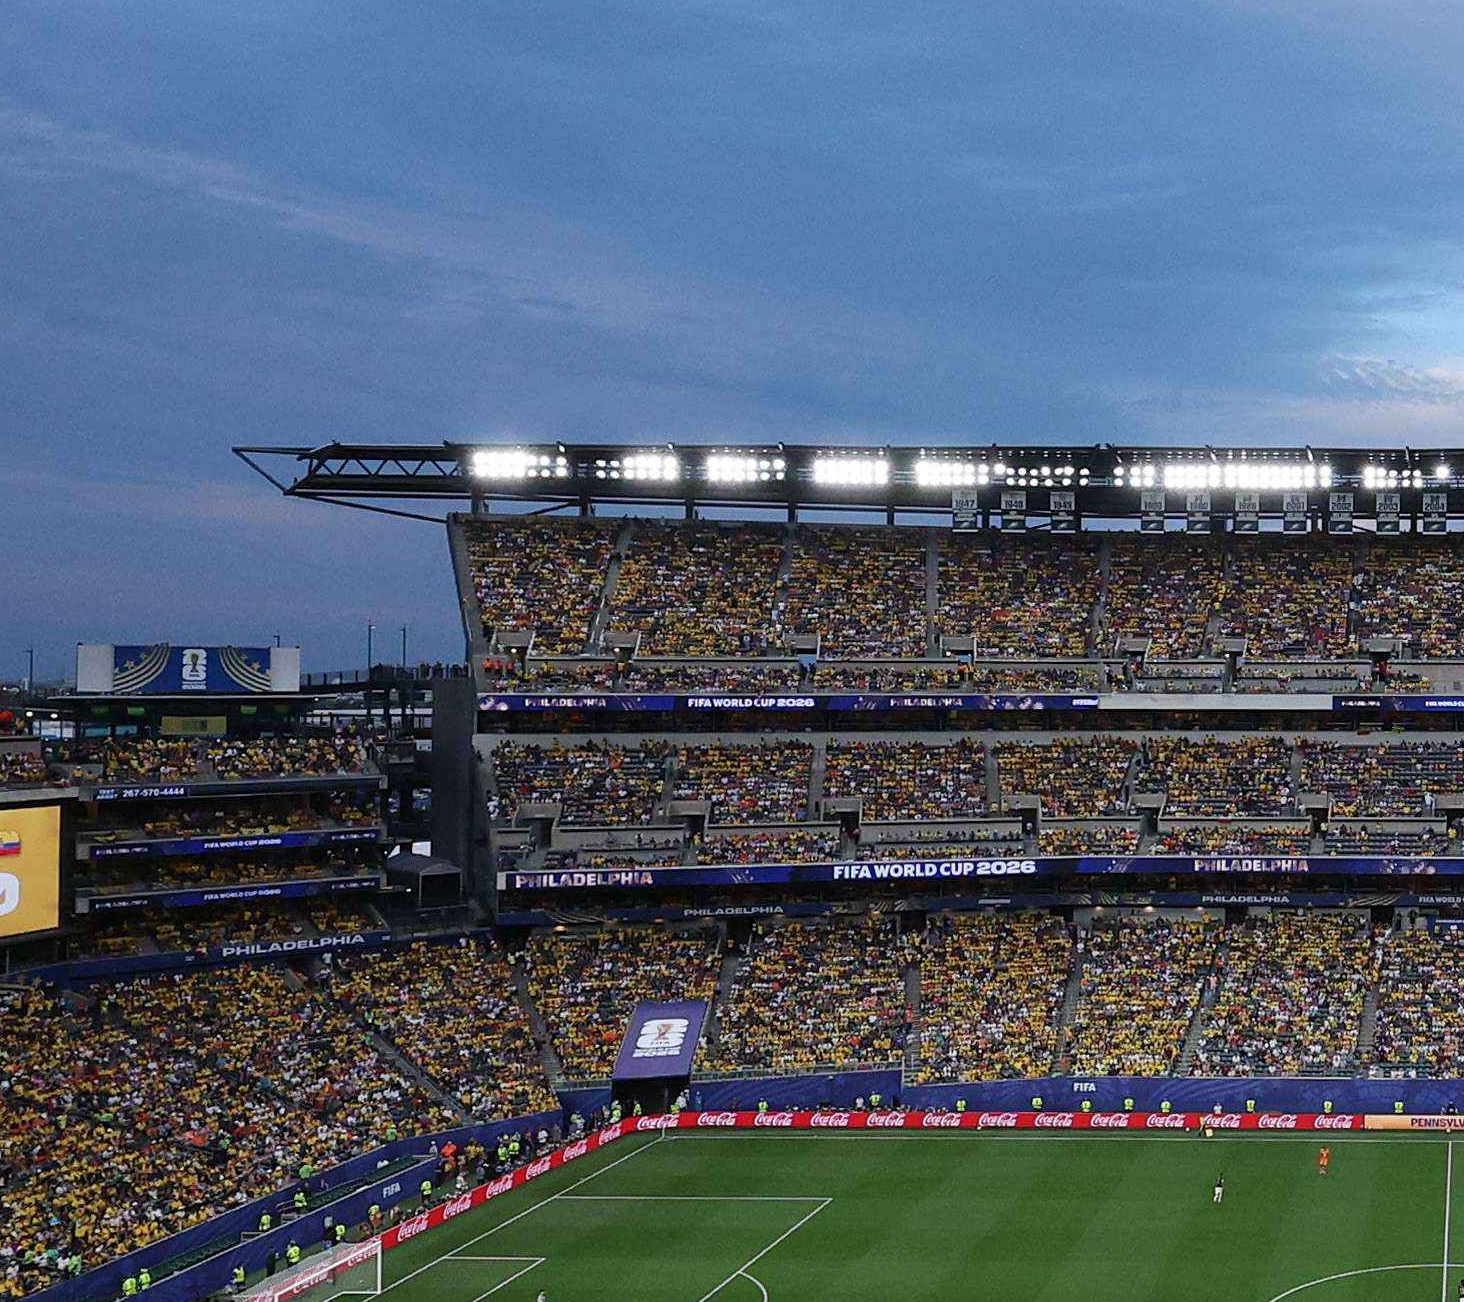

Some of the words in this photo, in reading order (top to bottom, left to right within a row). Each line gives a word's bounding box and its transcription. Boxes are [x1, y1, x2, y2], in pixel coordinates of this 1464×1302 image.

[688, 698, 711, 707] FIFA
[713, 698, 752, 707] WORLD
[754, 698, 776, 707] CUP
[777, 698, 815, 707] 2026
[122, 787, 184, 797] 267-570-4444
[833, 865, 868, 879] FIFA
[874, 863, 937, 879] WORLD
[940, 862, 973, 876] CUP
[976, 860, 1036, 875] 2026
[1195, 859, 1309, 872] PHILADELPHIA
[515, 871, 653, 889] PHILADELPHIA
[1203, 895, 1290, 904] PHILADELPHIA
[684, 905, 784, 917] PHILADELPHIA
[222, 933, 365, 957] PHILADELPHIA
[1073, 1081, 1096, 1093] FIFA
[382, 1180, 402, 1200] FIFA
